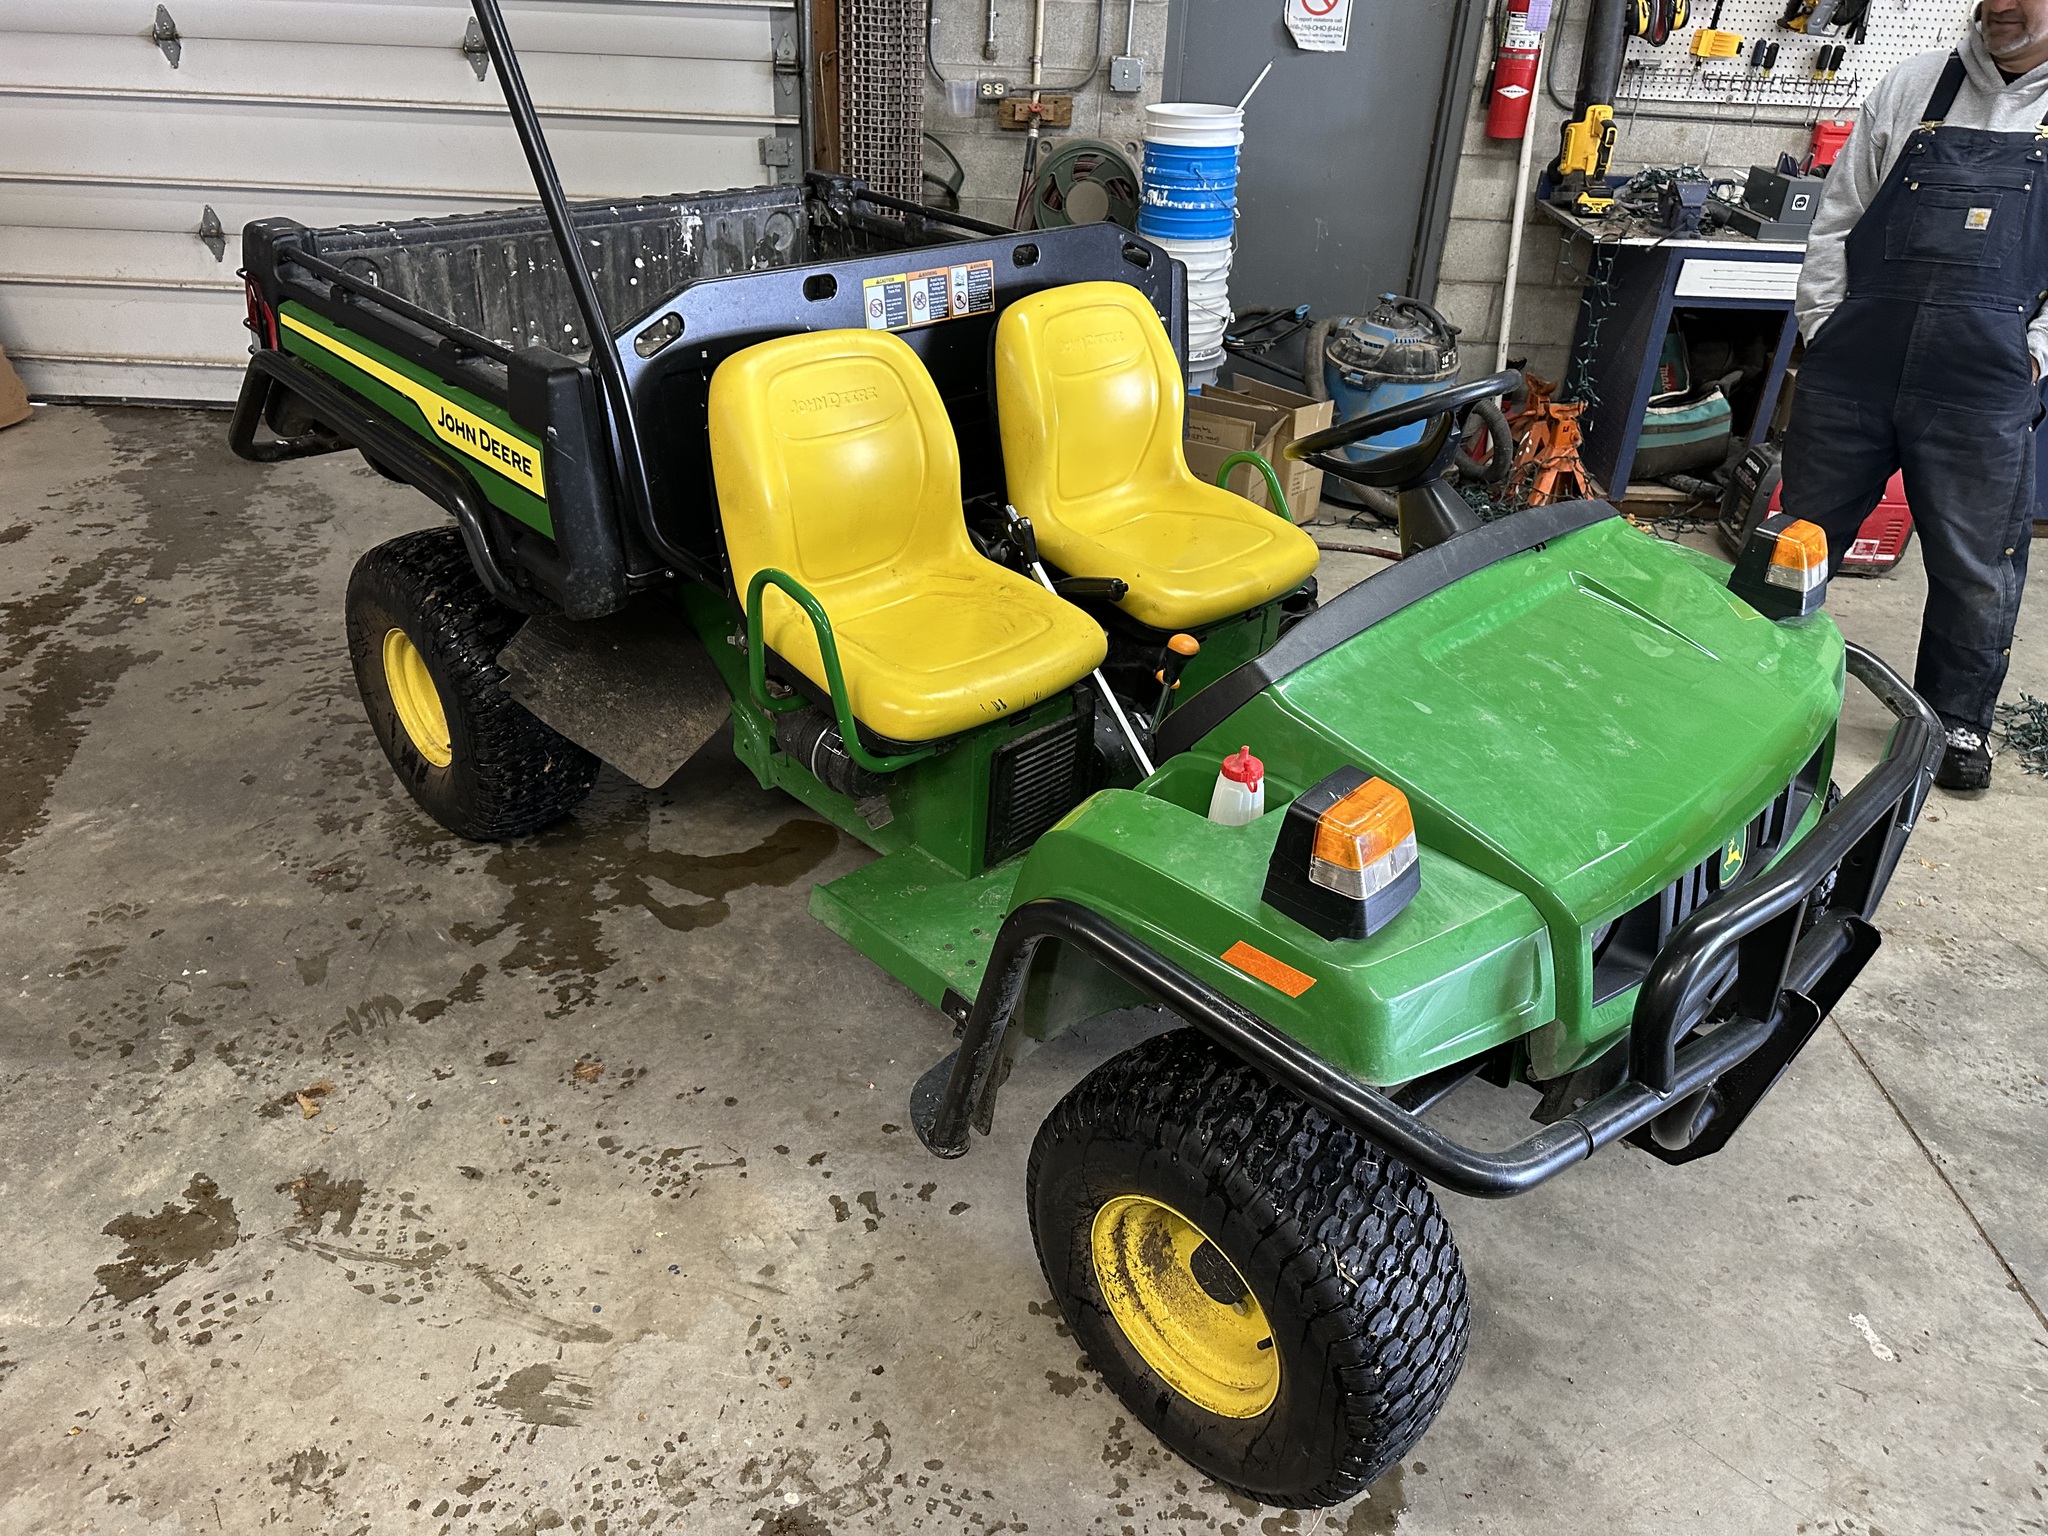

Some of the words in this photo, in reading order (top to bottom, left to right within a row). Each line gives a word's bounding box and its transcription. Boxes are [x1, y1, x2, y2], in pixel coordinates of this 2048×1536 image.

[790, 395, 828, 413] JOHN
[827, 386, 879, 408] DEERE
[438, 406, 477, 446] JOHN
[479, 428, 533, 478] DEERE
